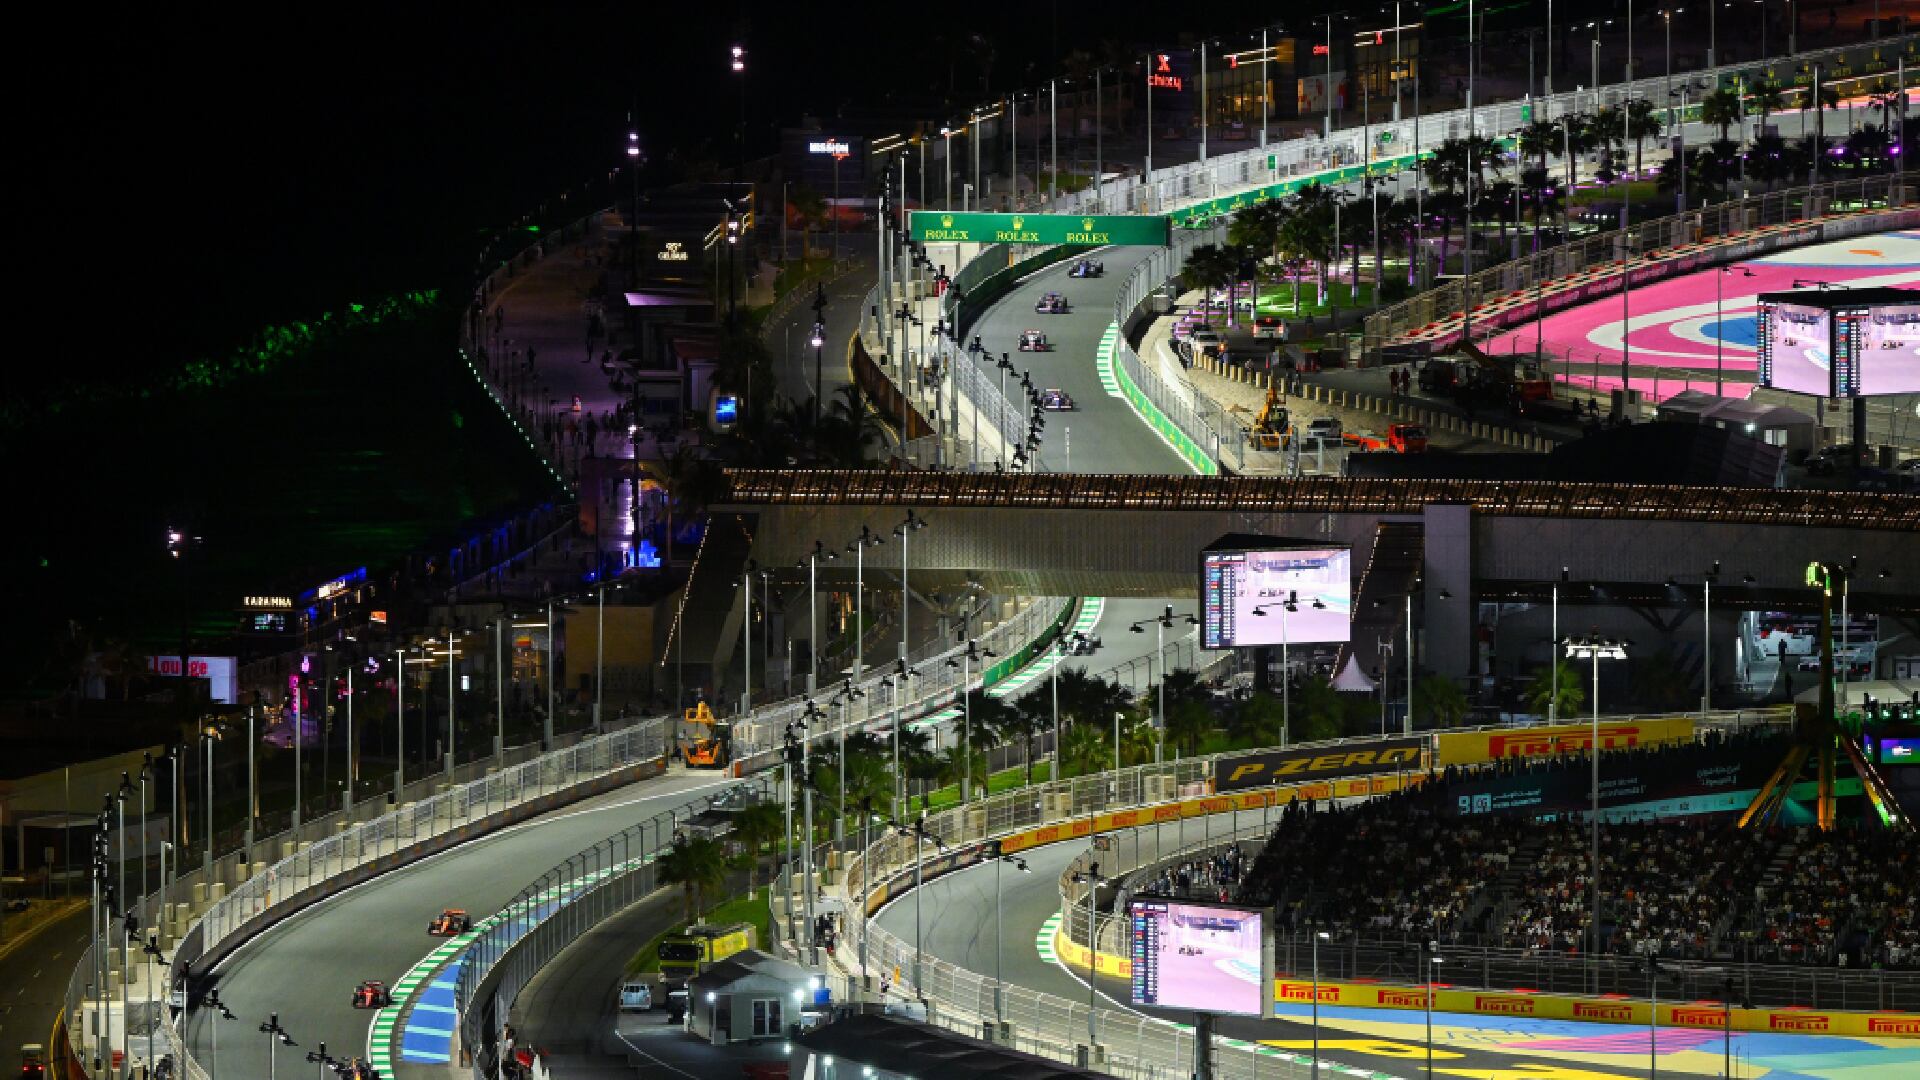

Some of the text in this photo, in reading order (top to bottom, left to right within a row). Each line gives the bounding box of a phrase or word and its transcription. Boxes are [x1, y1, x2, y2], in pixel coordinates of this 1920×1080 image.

[925, 230, 969, 240] ROLEX
[996, 231, 1039, 242] ROLEX
[1066, 232, 1110, 243] ROLEX
[1489, 727, 1640, 758] PIRELLI
[1229, 747, 1421, 781] P ZERO
[1281, 983, 1339, 1001] PIRELLI
[1378, 989, 1436, 1008] PIRELLI
[1475, 996, 1534, 1014] PIRELLI
[1573, 1002, 1631, 1021] PIRELLI
[1770, 1013, 1829, 1030] PIRELLI
[1868, 1017, 1920, 1033] PIRELL
